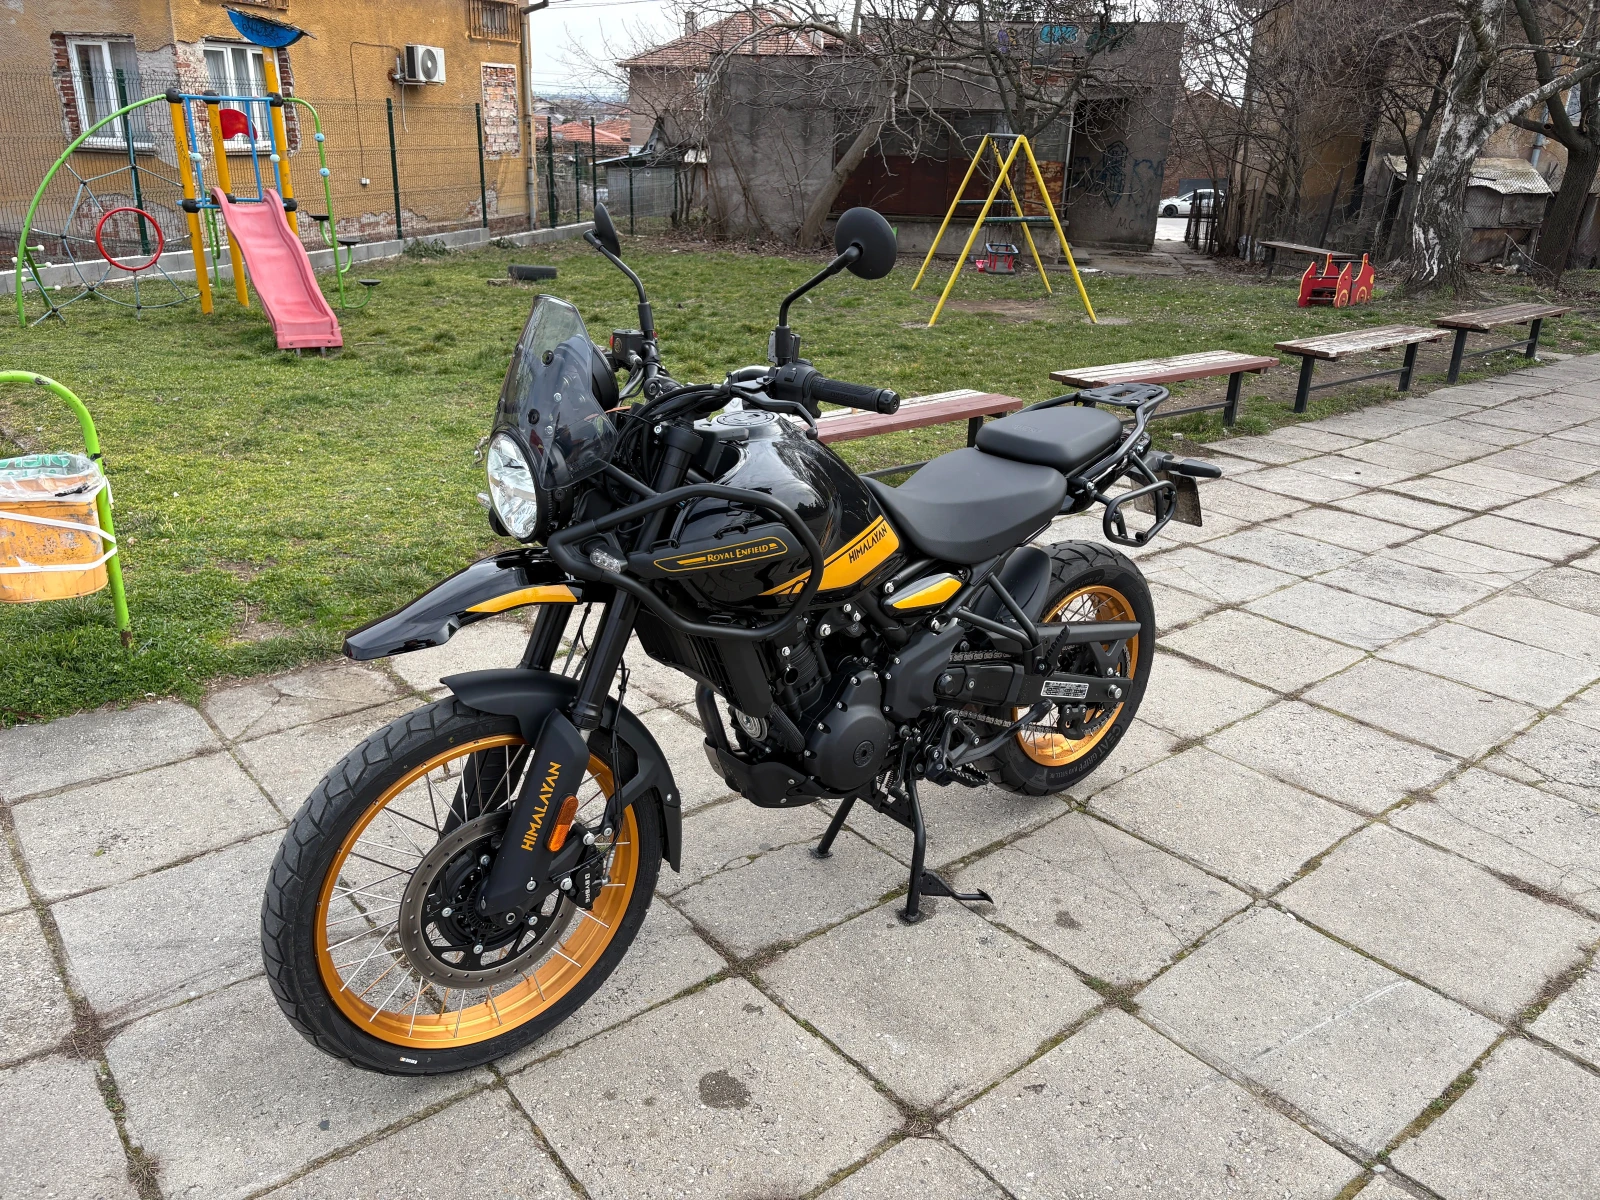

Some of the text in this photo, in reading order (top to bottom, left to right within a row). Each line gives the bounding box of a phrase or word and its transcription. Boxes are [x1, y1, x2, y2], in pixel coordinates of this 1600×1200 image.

[706, 544, 769, 562] ROYAL ENFIELD
[848, 523, 888, 564] HIMALAYAN
[1097, 723, 1123, 755] CEAT
[521, 761, 562, 851] HIMALAYAN
